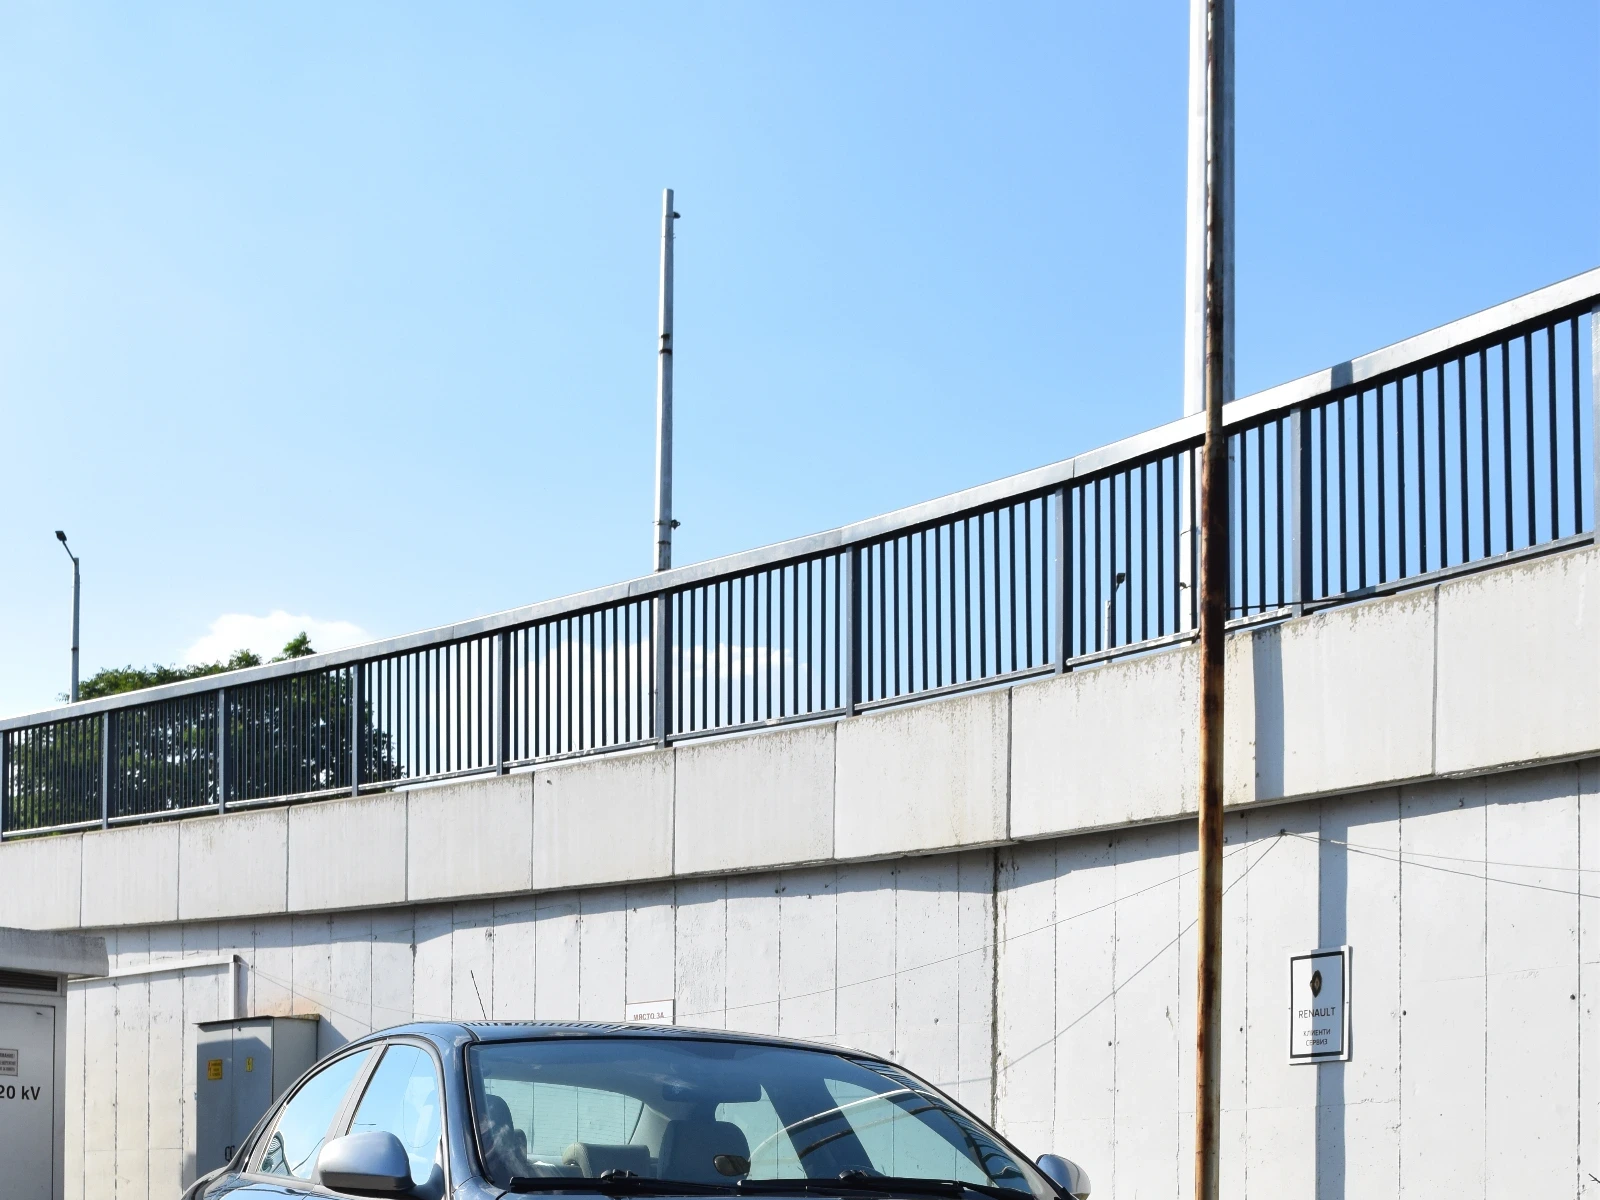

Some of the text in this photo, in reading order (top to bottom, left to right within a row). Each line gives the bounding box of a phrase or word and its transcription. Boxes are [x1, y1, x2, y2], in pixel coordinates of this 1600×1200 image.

[1298, 1006, 1336, 1018] RENAULT
[1305, 1038, 1328, 1046] СЕРВИЗ
[21, 1085, 41, 1101] kV
